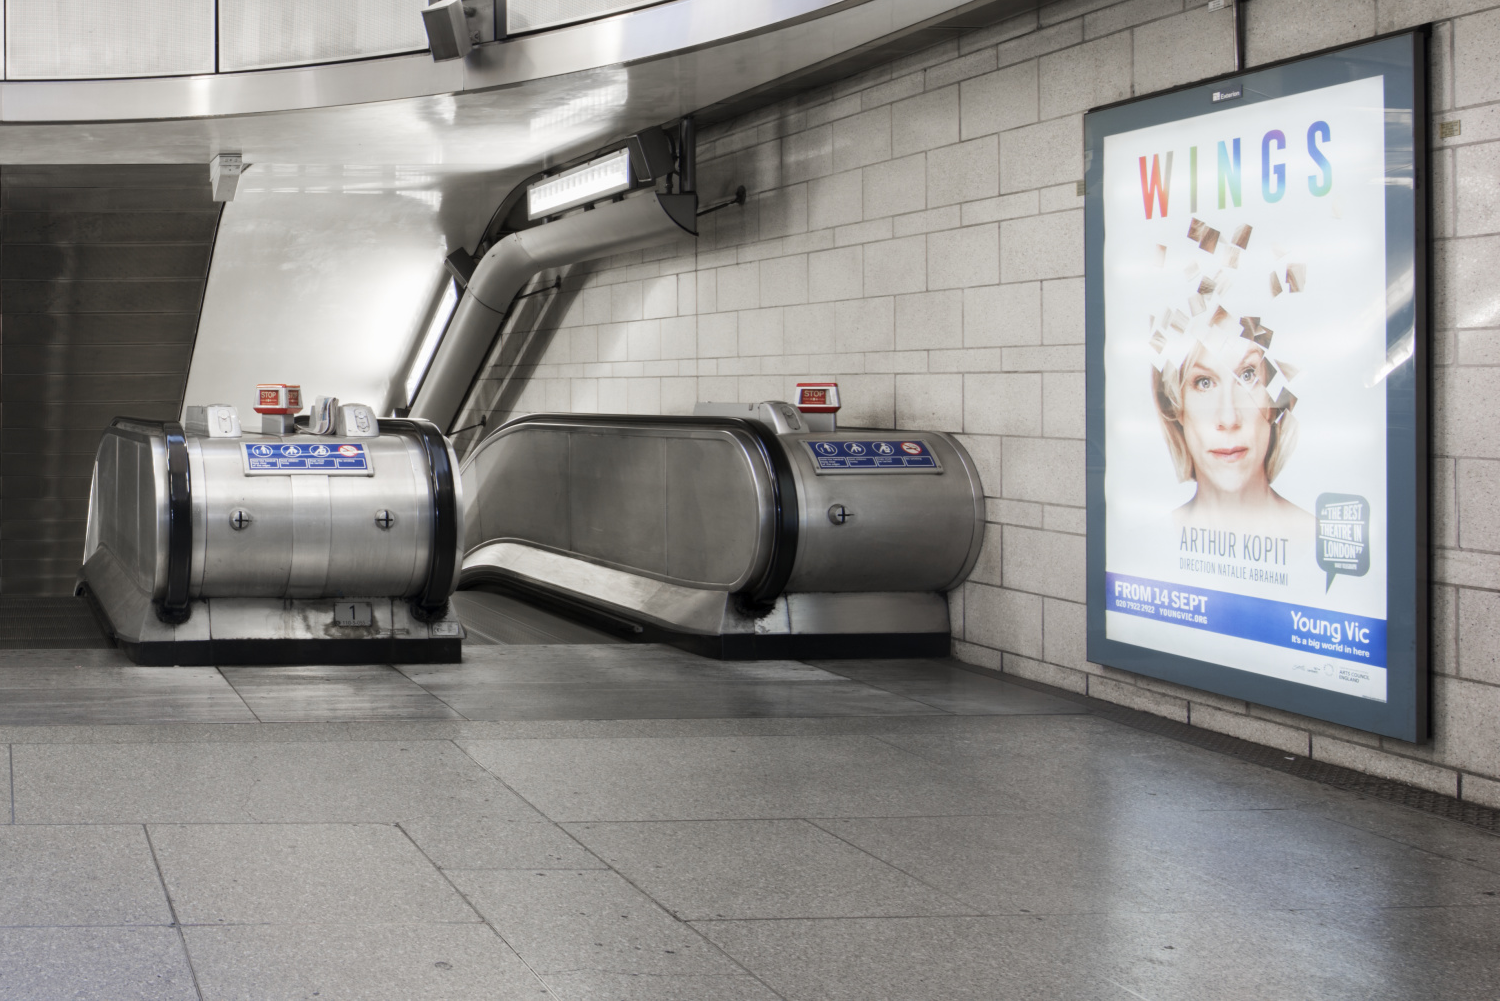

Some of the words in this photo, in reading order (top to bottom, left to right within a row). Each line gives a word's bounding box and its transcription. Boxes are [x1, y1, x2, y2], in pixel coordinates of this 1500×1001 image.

[1221, 90, 1241, 100] Exterion
[1139, 121, 1333, 220] WINGS
[261, 391, 276, 399] STOP
[1343, 503, 1362, 520] BEST
[1320, 523, 1352, 540] THEATRE
[1353, 524, 1362, 542] IN
[1180, 526, 1236, 558] ARTHUR
[1243, 534, 1288, 565] KOPIT
[1180, 557, 1216, 575] DIRECTION
[1218, 563, 1247, 579] NATALIE
[1249, 568, 1288, 586] ABRAHAMI
[1115, 581, 1152, 603] FROM
[1153, 587, 1169, 606] 14
[1171, 591, 1208, 613] SEPT
[349, 605, 355, 620] 1
[1115, 599, 1126, 608] 020
[1127, 601, 1141, 611] 7922
[1141, 604, 1155, 614] 2922
[1159, 607, 1208, 624] YOUNGVIC.ORG
[1291, 610, 1341, 643] Young
[1344, 620, 1370, 644] Vic
[1308, 638, 1320, 649] big
[1321, 641, 1343, 652] world
[1344, 645, 1352, 654] in
[1353, 647, 1370, 658] here
[1339, 675, 1360, 684] ENGLAND
[1351, 672, 1370, 681] COUNCIL
